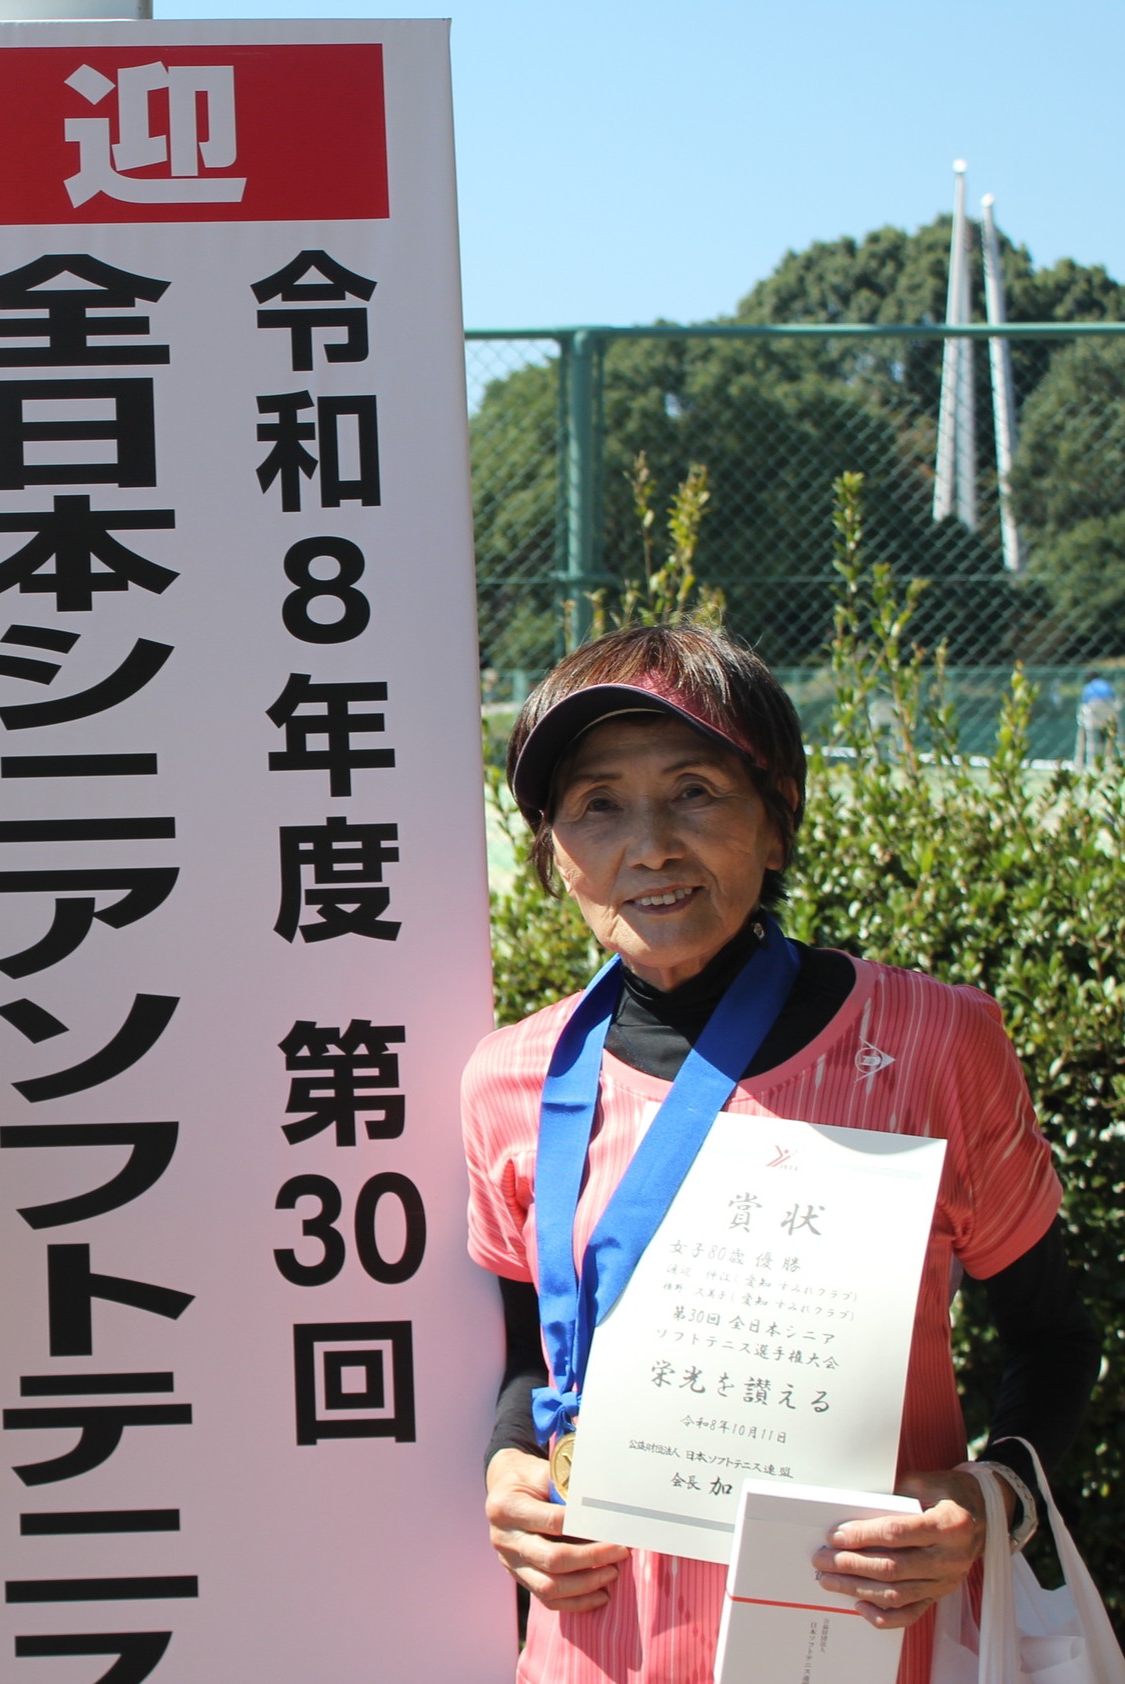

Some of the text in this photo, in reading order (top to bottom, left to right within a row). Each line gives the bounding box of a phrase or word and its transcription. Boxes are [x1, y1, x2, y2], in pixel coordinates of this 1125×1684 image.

[251, 250, 427, 1446] 令和8年度 第30回
[728, 1192, 826, 1236] 賞状
[673, 1305, 836, 1345] 第30回 全日本シニア
[656, 1328, 840, 1370] ソフトテニス選手権大会
[651, 1359, 830, 1413] 栄光を讃える
[680, 1414, 788, 1444] 令和8年10月11日
[670, 1472, 734, 1496] 会長 加
[685, 1450, 794, 1479] 日本ソフトテニス連盟
